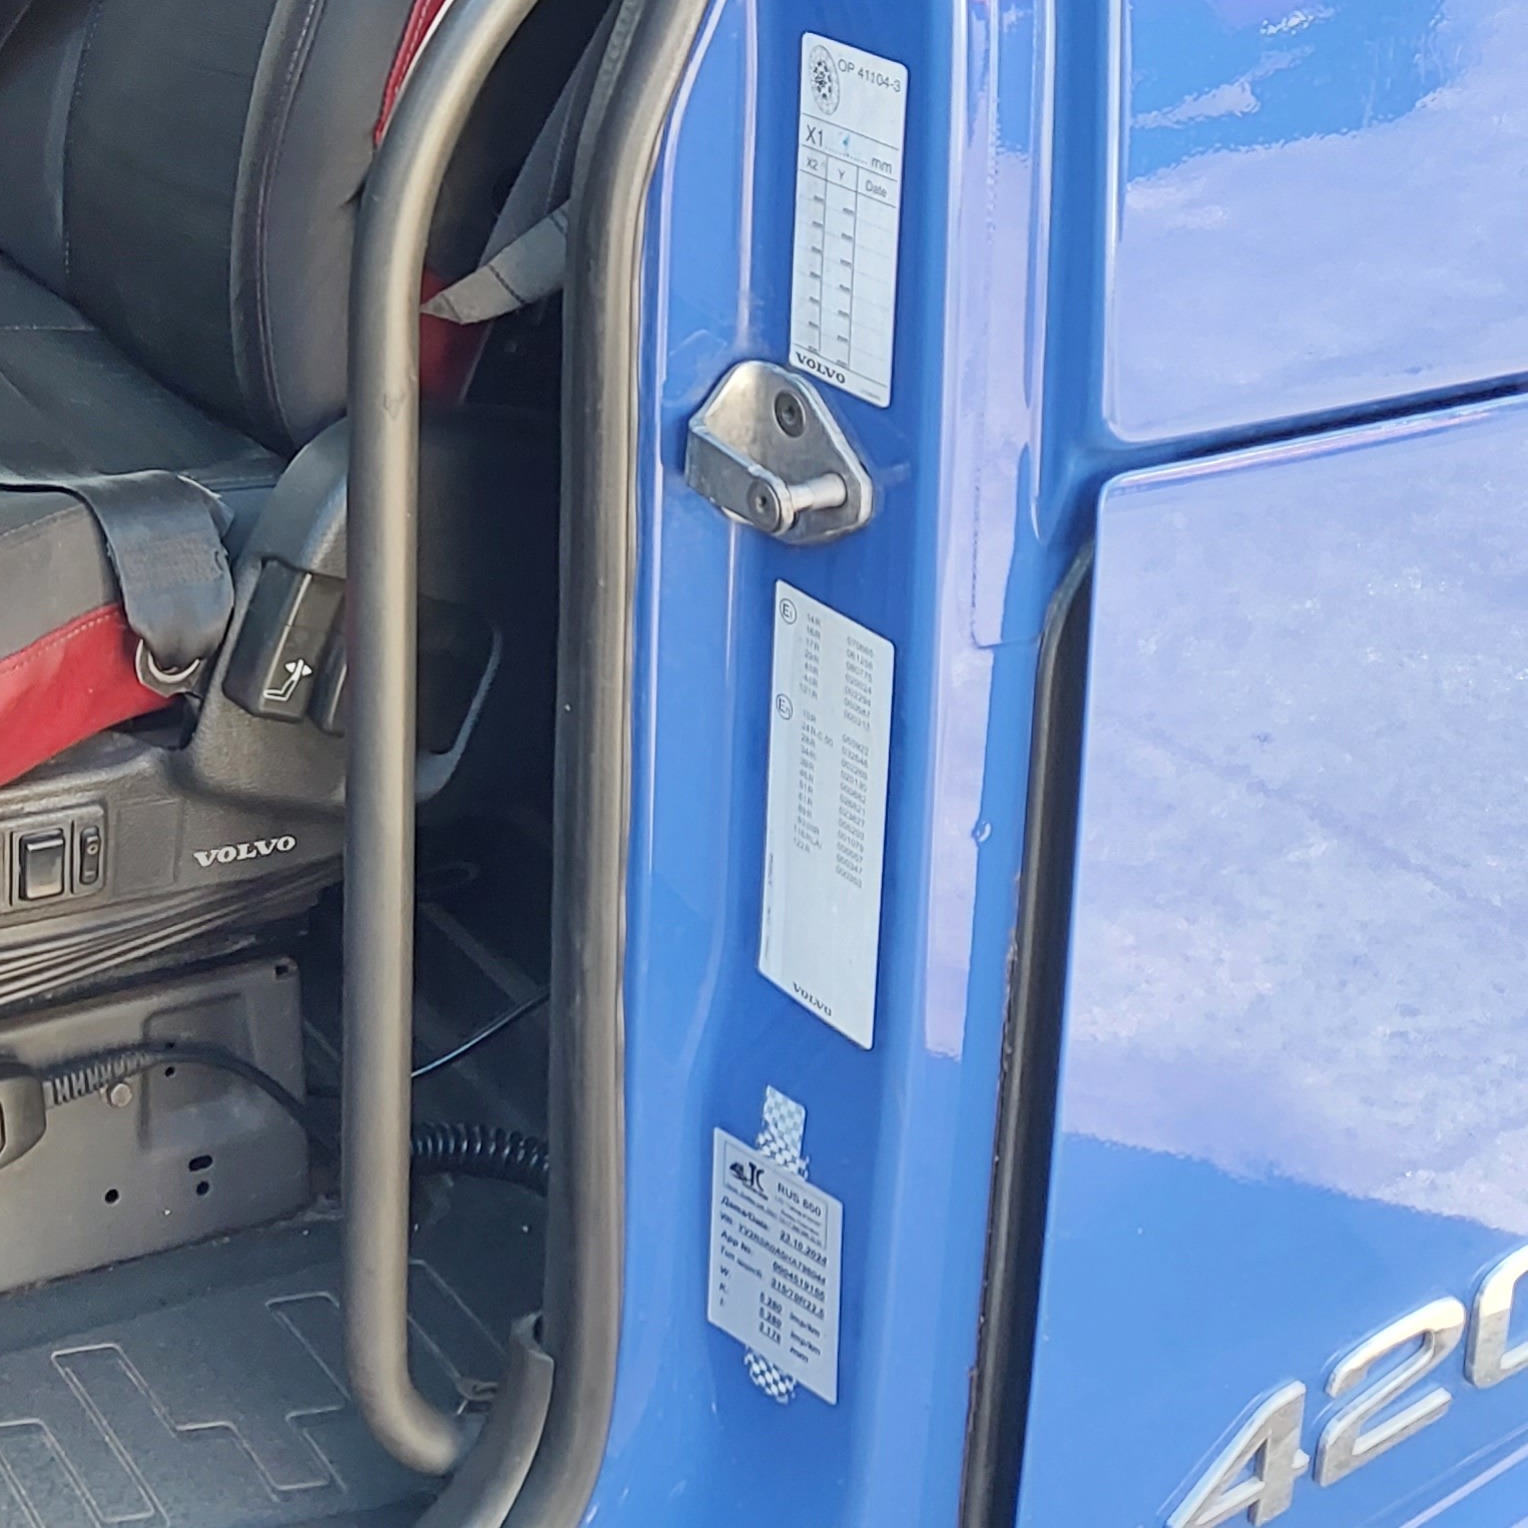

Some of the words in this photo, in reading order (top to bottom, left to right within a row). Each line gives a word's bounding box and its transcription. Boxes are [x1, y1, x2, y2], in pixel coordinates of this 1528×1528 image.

[838, 59, 855, 73] OP
[857, 67, 901, 93] 41104-3
[805, 124, 823, 147] X1
[872, 157, 892, 175] mm
[838, 168, 846, 181] Y
[865, 179, 888, 198] Date
[795, 352, 846, 384] VOLVO
[192, 835, 296, 868] VOLVO
[792, 981, 833, 1017] VOLVO
